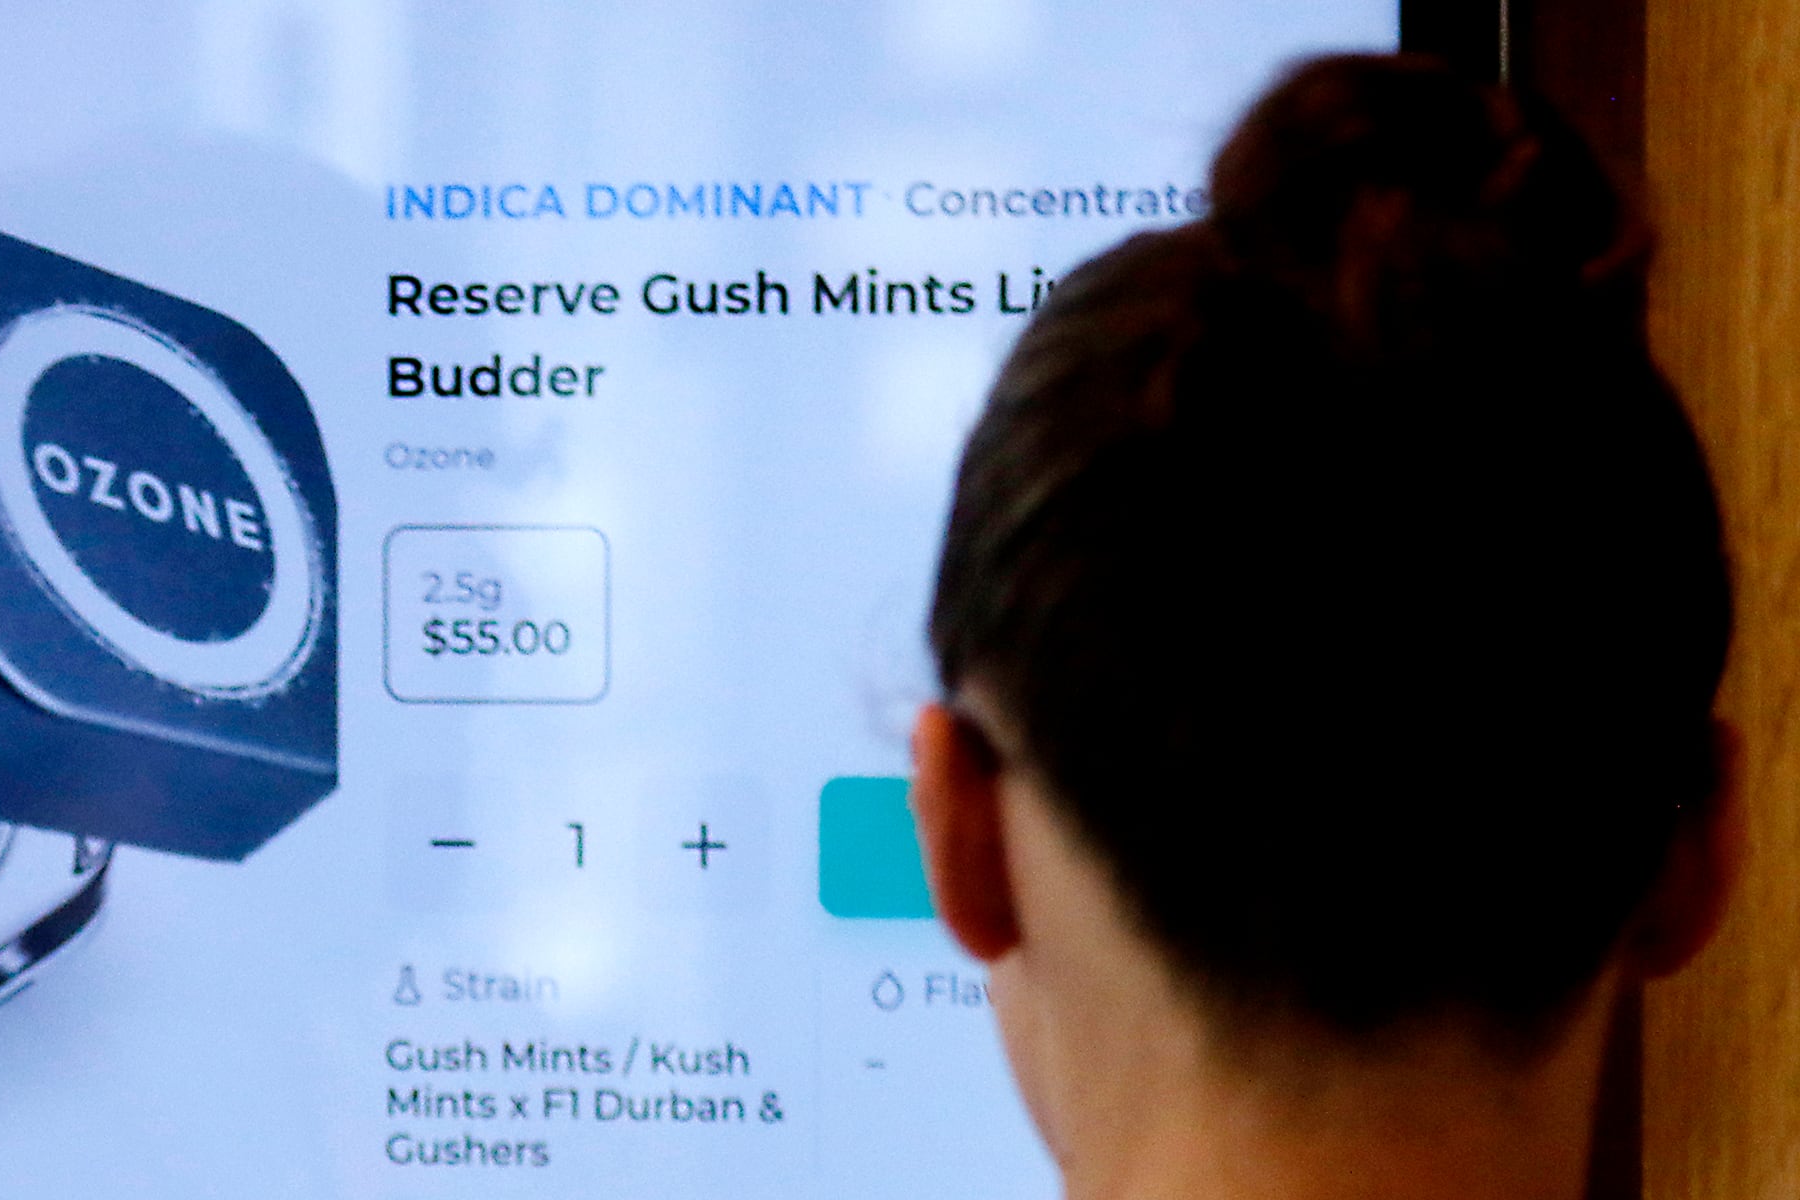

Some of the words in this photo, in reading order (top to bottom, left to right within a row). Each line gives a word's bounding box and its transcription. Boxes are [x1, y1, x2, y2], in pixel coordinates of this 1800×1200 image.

[385, 183, 566, 221] INDICA
[584, 181, 870, 220] DOMINANT
[904, 181, 1212, 218] Concentrate
[386, 273, 622, 317] Reserve
[640, 268, 791, 317] Gush
[812, 267, 977, 315] Mints
[998, 266, 1055, 314] Li
[386, 353, 606, 400] Budder
[382, 440, 499, 472] Ozone
[33, 442, 265, 552] OZONE
[422, 570, 504, 612] 2.5g
[422, 616, 572, 658] $55.00
[565, 821, 586, 869] 1
[442, 967, 560, 1004] Strain
[924, 973, 992, 1007] Fla
[384, 1038, 489, 1073] Gush
[502, 1040, 614, 1075] Mints
[650, 1041, 751, 1076] Kush
[386, 1086, 498, 1120] Mints
[510, 1095, 529, 1119] x
[542, 1087, 581, 1120] F1
[593, 1087, 747, 1123] Durban
[757, 1090, 785, 1125] &
[384, 1131, 551, 1168] Gushers
